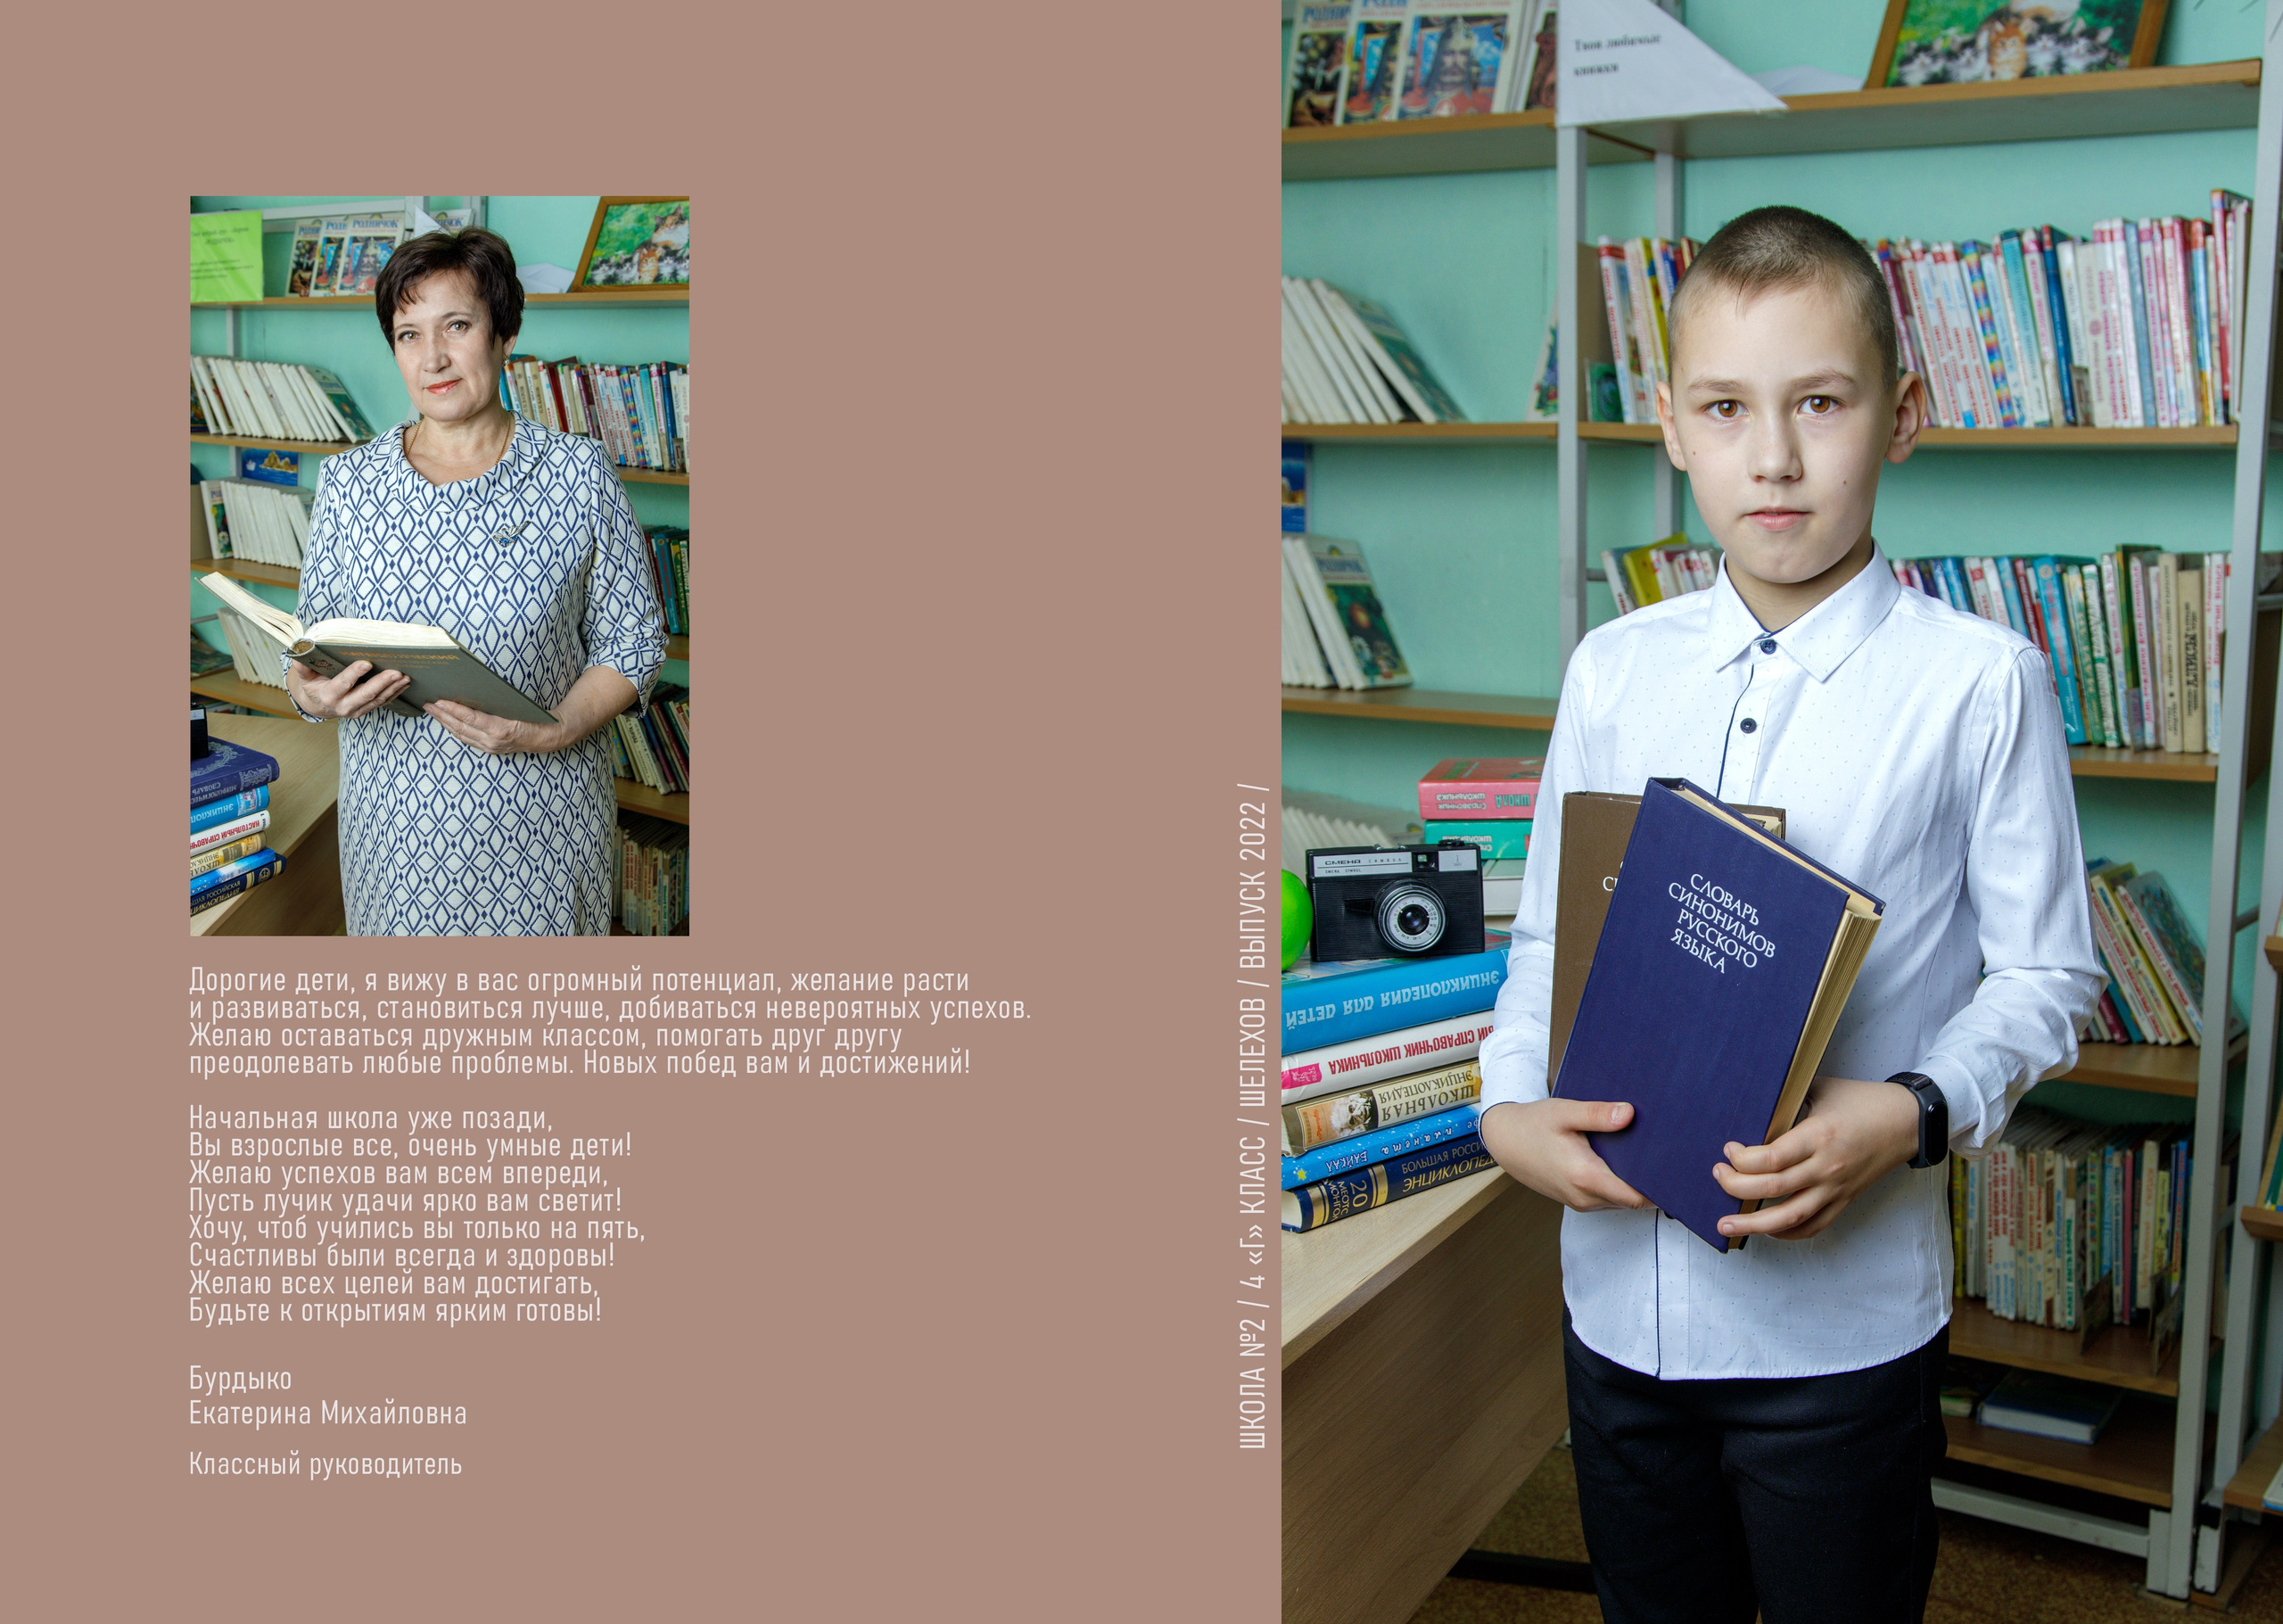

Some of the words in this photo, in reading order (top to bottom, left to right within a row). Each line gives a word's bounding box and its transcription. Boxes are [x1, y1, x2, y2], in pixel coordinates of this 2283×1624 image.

[192, 782, 221, 796] СЛОВАРЬ
[221, 820, 260, 840] НАСТОЛЬНЫЙ
[1690, 874, 1760, 926] СЛОВАРЬ
[1669, 882, 1776, 959] СИНОНИМОВ
[1670, 928, 1726, 974] ЯЗЫКА
[1677, 909, 1758, 968] РУССКОГО
[1381, 970, 1500, 1007] ЭНЦИКЛОПЕДИЯ
[1285, 1004, 1336, 1030] ДЕТЕЙ
[1343, 996, 1374, 1016] ДЛЯ
[1404, 1029, 1475, 1059] СПРАВОЧНИК
[1328, 1046, 1402, 1076] ШКОЛЬНИКА
[1378, 1069, 1473, 1104] ЭНЦИКЛОПЕДИЯ
[1381, 1084, 1474, 1122] ШКОЛЬНАЯ
[1401, 1149, 1449, 1175] БОЛЬШАЯ
[1337, 1181, 1350, 1216] МЕОТС
[1349, 1179, 1369, 1208] 20
